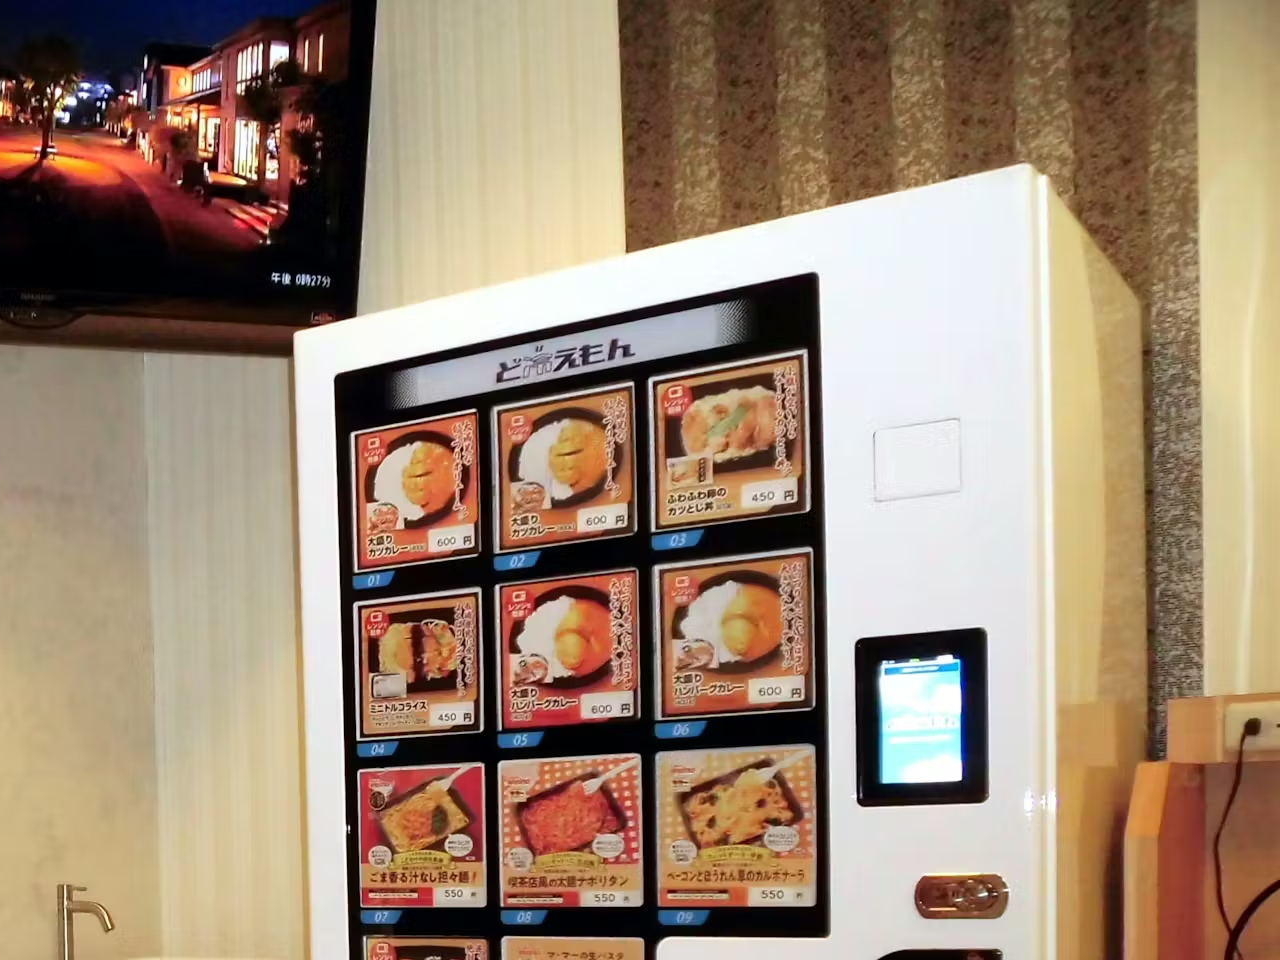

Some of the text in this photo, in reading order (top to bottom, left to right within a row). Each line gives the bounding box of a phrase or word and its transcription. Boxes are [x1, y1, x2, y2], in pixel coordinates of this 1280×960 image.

[271, 272, 331, 288] 午後 0時27分
[668, 488, 726, 503] ふわふわ卵の
[752, 490, 794, 502] 450 円
[668, 502, 714, 516] カツとじ丼
[586, 515, 625, 526] 600 円
[511, 525, 555, 538] カツカレー
[437, 536, 456, 547] 600
[463, 536, 472, 546] 円
[670, 534, 687, 546] 03
[368, 545, 409, 558] カツカレー
[510, 556, 525, 568] 02
[368, 574, 380, 586] 01
[674, 683, 745, 696] ハンバーグカレー
[758, 686, 802, 698] 600 円
[370, 701, 428, 713] ミニトルコライス
[511, 697, 578, 711] ハンバーグカレー
[591, 704, 631, 714] 600 円
[438, 712, 457, 722] 450
[464, 712, 472, 722] 円
[673, 723, 689, 736] 06
[513, 734, 528, 746] 05
[371, 744, 385, 755] 04
[444, 889, 463, 898] 550
[594, 893, 615, 903] 550
[761, 890, 785, 899] 550
[375, 911, 389, 923] 07
[517, 911, 532, 923] 08
[676, 911, 693, 923] 09
